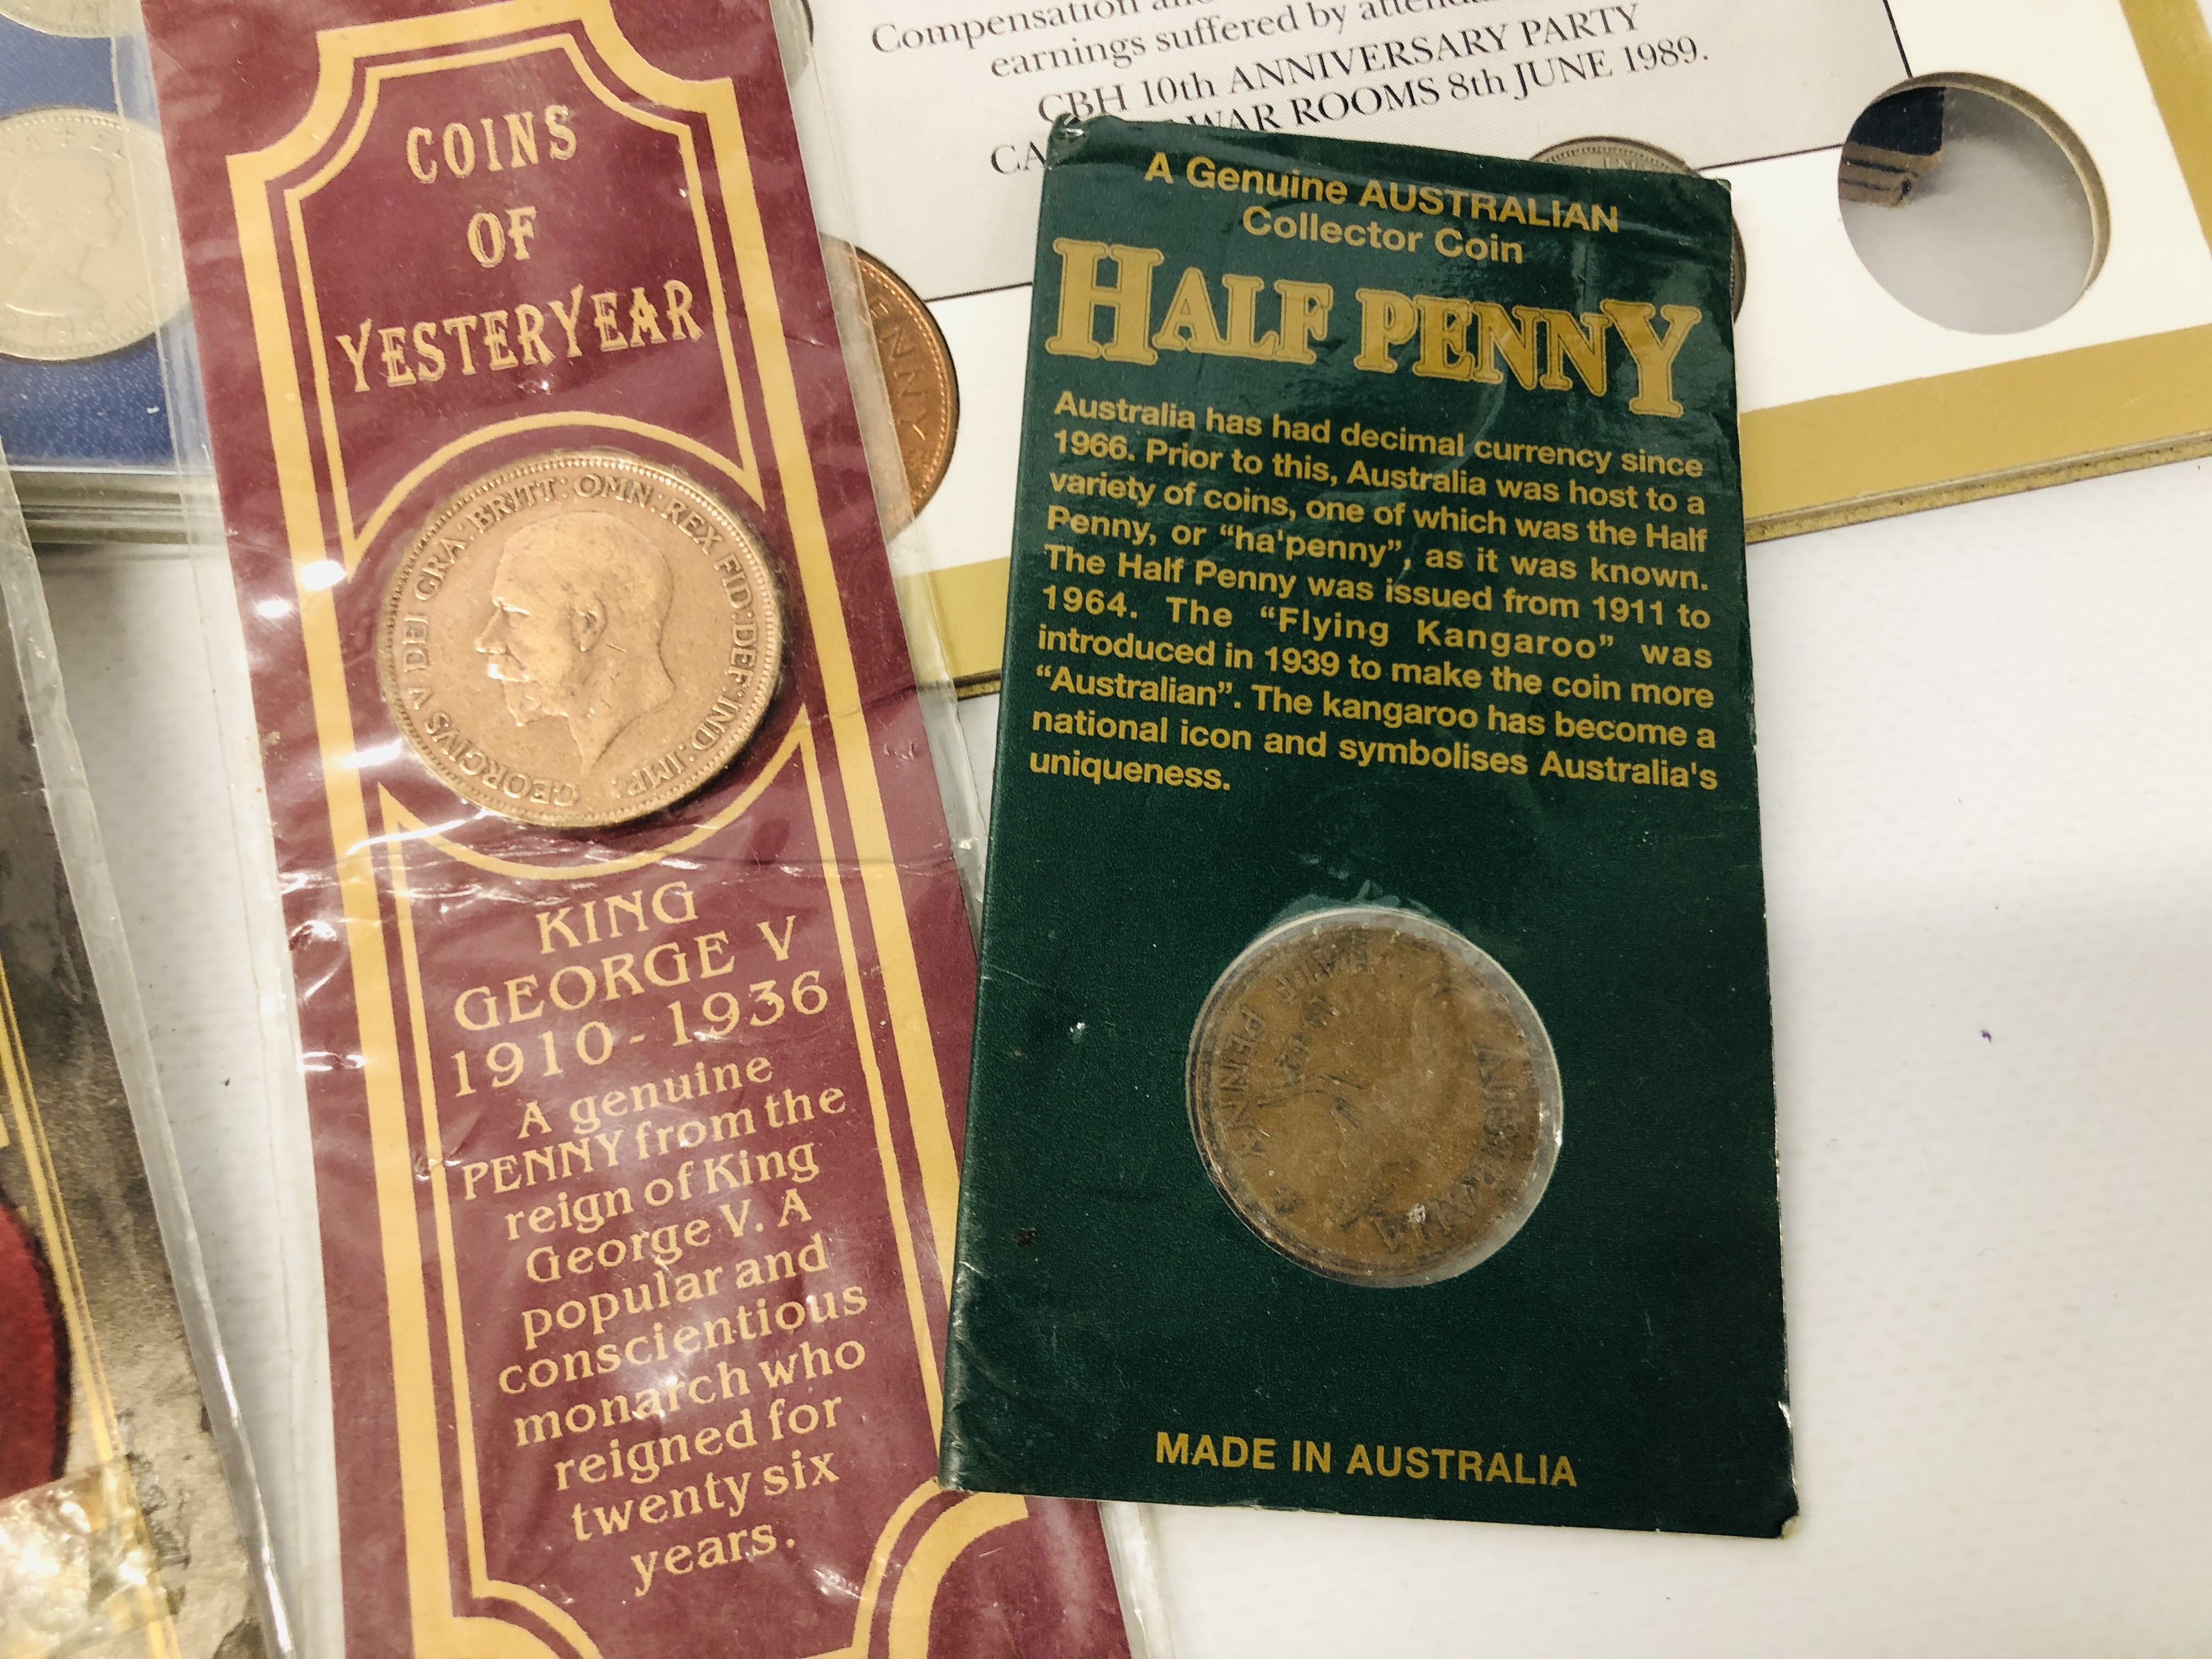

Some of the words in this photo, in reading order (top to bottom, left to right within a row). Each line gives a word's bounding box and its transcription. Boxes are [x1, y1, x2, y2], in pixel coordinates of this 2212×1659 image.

[872, 0, 1140, 53] Compensation
[990, 34, 1147, 78] earnings
[1155, 4, 1299, 53] suffered
[1306, 1, 1347, 35] by
[1038, 84, 1128, 123] CBH
[1143, 71, 1216, 109] 10th
[1229, 23, 1509, 94] ANNIVERSARY
[1519, 4, 1639, 48] PARTY
[1290, 78, 1441, 126] ROOMS
[1448, 70, 1506, 100] 8th
[1512, 49, 1613, 99] JUNE
[1623, 36, 1708, 73] 1989.
[407, 105, 576, 183] COINS
[1146, 152, 1172, 182] A
[1187, 156, 1347, 204] Genuine
[1359, 180, 1618, 232] AUSTRALIAN
[467, 207, 536, 267] OF
[1243, 206, 1423, 251] Collector
[1435, 228, 1522, 263] Coin
[336, 280, 702, 392] YESTERYEAR
[1045, 238, 1333, 365] HALF
[1354, 288, 1702, 417] PENNY
[1055, 391, 1195, 428] Australia
[1206, 408, 1262, 436] has
[1273, 414, 1330, 443] had
[1341, 422, 1464, 456] decimal
[1475, 441, 1611, 473] currency
[1622, 449, 1702, 477] since
[1056, 430, 1135, 461] 1966.
[1147, 439, 1223, 470] Prior
[1232, 449, 1262, 474] to
[1273, 453, 1337, 486] this,
[1347, 460, 1486, 495] Australia
[1496, 479, 1559, 501] was
[1570, 479, 1637, 509] host
[1646, 488, 1677, 511] to
[1688, 496, 1705, 514] a
[659, 499, 724, 555] REX
[1048, 505, 1156, 545] Penny,
[1172, 525, 1206, 545] or
[1220, 524, 1410, 569] “ha'penny”,
[1426, 549, 1463, 569] as
[1477, 548, 1498, 572] it
[1511, 556, 1577, 579] was
[1591, 557, 1707, 590] known.
[1051, 472, 1155, 506] variety
[1164, 482, 1196, 506] of
[1204, 488, 1296, 520] coins,
[1306, 500, 1364, 522] one
[1374, 503, 1405, 526] of
[1413, 506, 1506, 534] which
[1515, 518, 1578, 541] was
[1587, 520, 1637, 546] the
[1646, 523, 1707, 551] Half
[1043, 585, 1137, 618] 1964.
[1166, 597, 1232, 627] The
[1261, 606, 1388, 647] “Flying
[1418, 619, 1613, 658] Kangaroo”
[1641, 645, 1712, 668] was
[1045, 544, 1105, 574] The
[1119, 552, 1184, 583] Half
[1196, 560, 1296, 599] Penny
[1308, 577, 1373, 600] was
[1386, 578, 1492, 610] issued
[1503, 588, 1579, 618] from
[1593, 596, 1662, 625] 1911
[1678, 604, 1710, 628] to
[403, 612, 428, 674] DEI
[1039, 624, 1215, 665] introduced
[1226, 642, 1252, 669] in
[1265, 647, 1339, 676] 1939
[1349, 654, 1381, 680] to
[1392, 662, 1482, 689] make
[1491, 666, 1542, 694] the
[1553, 674, 1621, 701] coin
[1631, 683, 1713, 708] more
[407, 686, 435, 710] V
[1037, 665, 1240, 708] “Australian”.
[1251, 685, 1312, 714] The
[1324, 691, 1478, 728] kangaroo
[1488, 704, 1545, 735] has
[1556, 711, 1687, 746] become
[1697, 729, 1715, 748] a
[1030, 750, 1229, 790] uniqueness.
[1033, 710, 1167, 742] national
[1181, 719, 1251, 750] icon
[1265, 731, 1326, 757] and
[1340, 739, 1528, 775] symbolises
[1541, 751, 1717, 789] Australia's
[535, 882, 697, 954] KING
[454, 931, 735, 1030] GEORGE
[757, 916, 794, 961] V
[453, 1021, 613, 1097] 1910
[668, 970, 827, 1046] 1936
[519, 1101, 551, 1138] A
[570, 1056, 772, 1135] genuine
[462, 1130, 622, 1200] PENNY
[636, 1108, 755, 1159] from
[765, 1088, 845, 1127] the
[505, 1188, 633, 1240] reign
[644, 1161, 693, 1206] of
[704, 1143, 819, 1193] King
[526, 1220, 710, 1282] George
[720, 1200, 763, 1237] V.
[778, 1188, 811, 1227] A
[521, 1265, 724, 1350] popular
[736, 1233, 828, 1288] and
[499, 1285, 868, 1395] conscientious
[514, 1361, 751, 1446] monarch
[759, 1341, 865, 1388] who
[554, 1408, 758, 1492] reigned
[769, 1397, 842, 1441] for
[1156, 1432, 1276, 1469] MADE
[1293, 1441, 1330, 1472] IN
[1347, 1444, 1576, 1486] AUSTRALIA
[572, 1472, 751, 1541] twenty
[763, 1450, 839, 1496] six
[631, 1525, 794, 1596] years.
